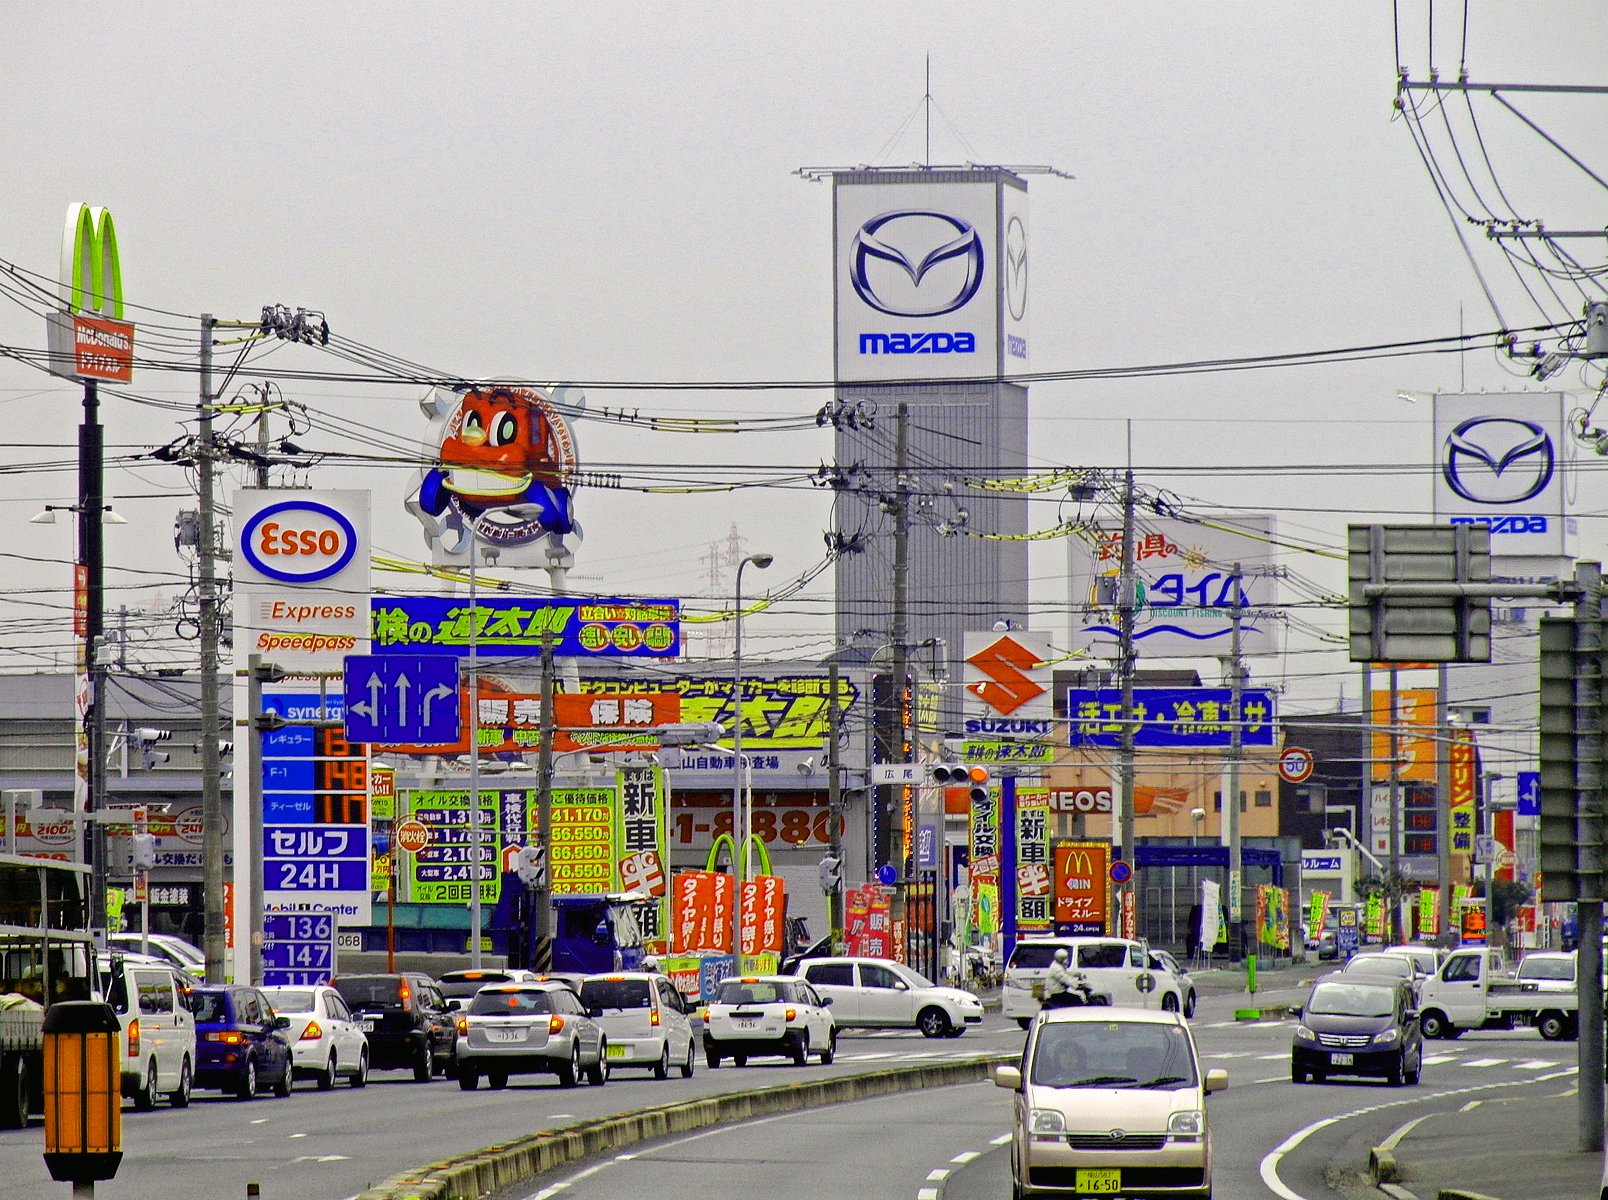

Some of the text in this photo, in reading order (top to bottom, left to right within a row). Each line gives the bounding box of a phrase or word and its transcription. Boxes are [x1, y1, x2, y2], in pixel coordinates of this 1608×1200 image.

[271, 601, 356, 622] Express
[371, 606, 576, 646] 検の速太郎
[257, 633, 356, 652] Speedpass
[965, 719, 1049, 734] SUZUKI
[269, 735, 311, 745] レギュラー
[270, 767, 287, 778] F-1
[1285, 757, 1306, 772] 50
[884, 768, 914, 780] 広尾
[271, 801, 311, 811] ディーゼル
[415, 795, 493, 806] オイル交換格
[671, 810, 846, 844] 1-8880
[271, 830, 348, 855] セルフ
[280, 863, 339, 889] 24H
[1071, 909, 1100, 918] スルー
[288, 917, 330, 939] 136
[286, 945, 329, 967] 147
